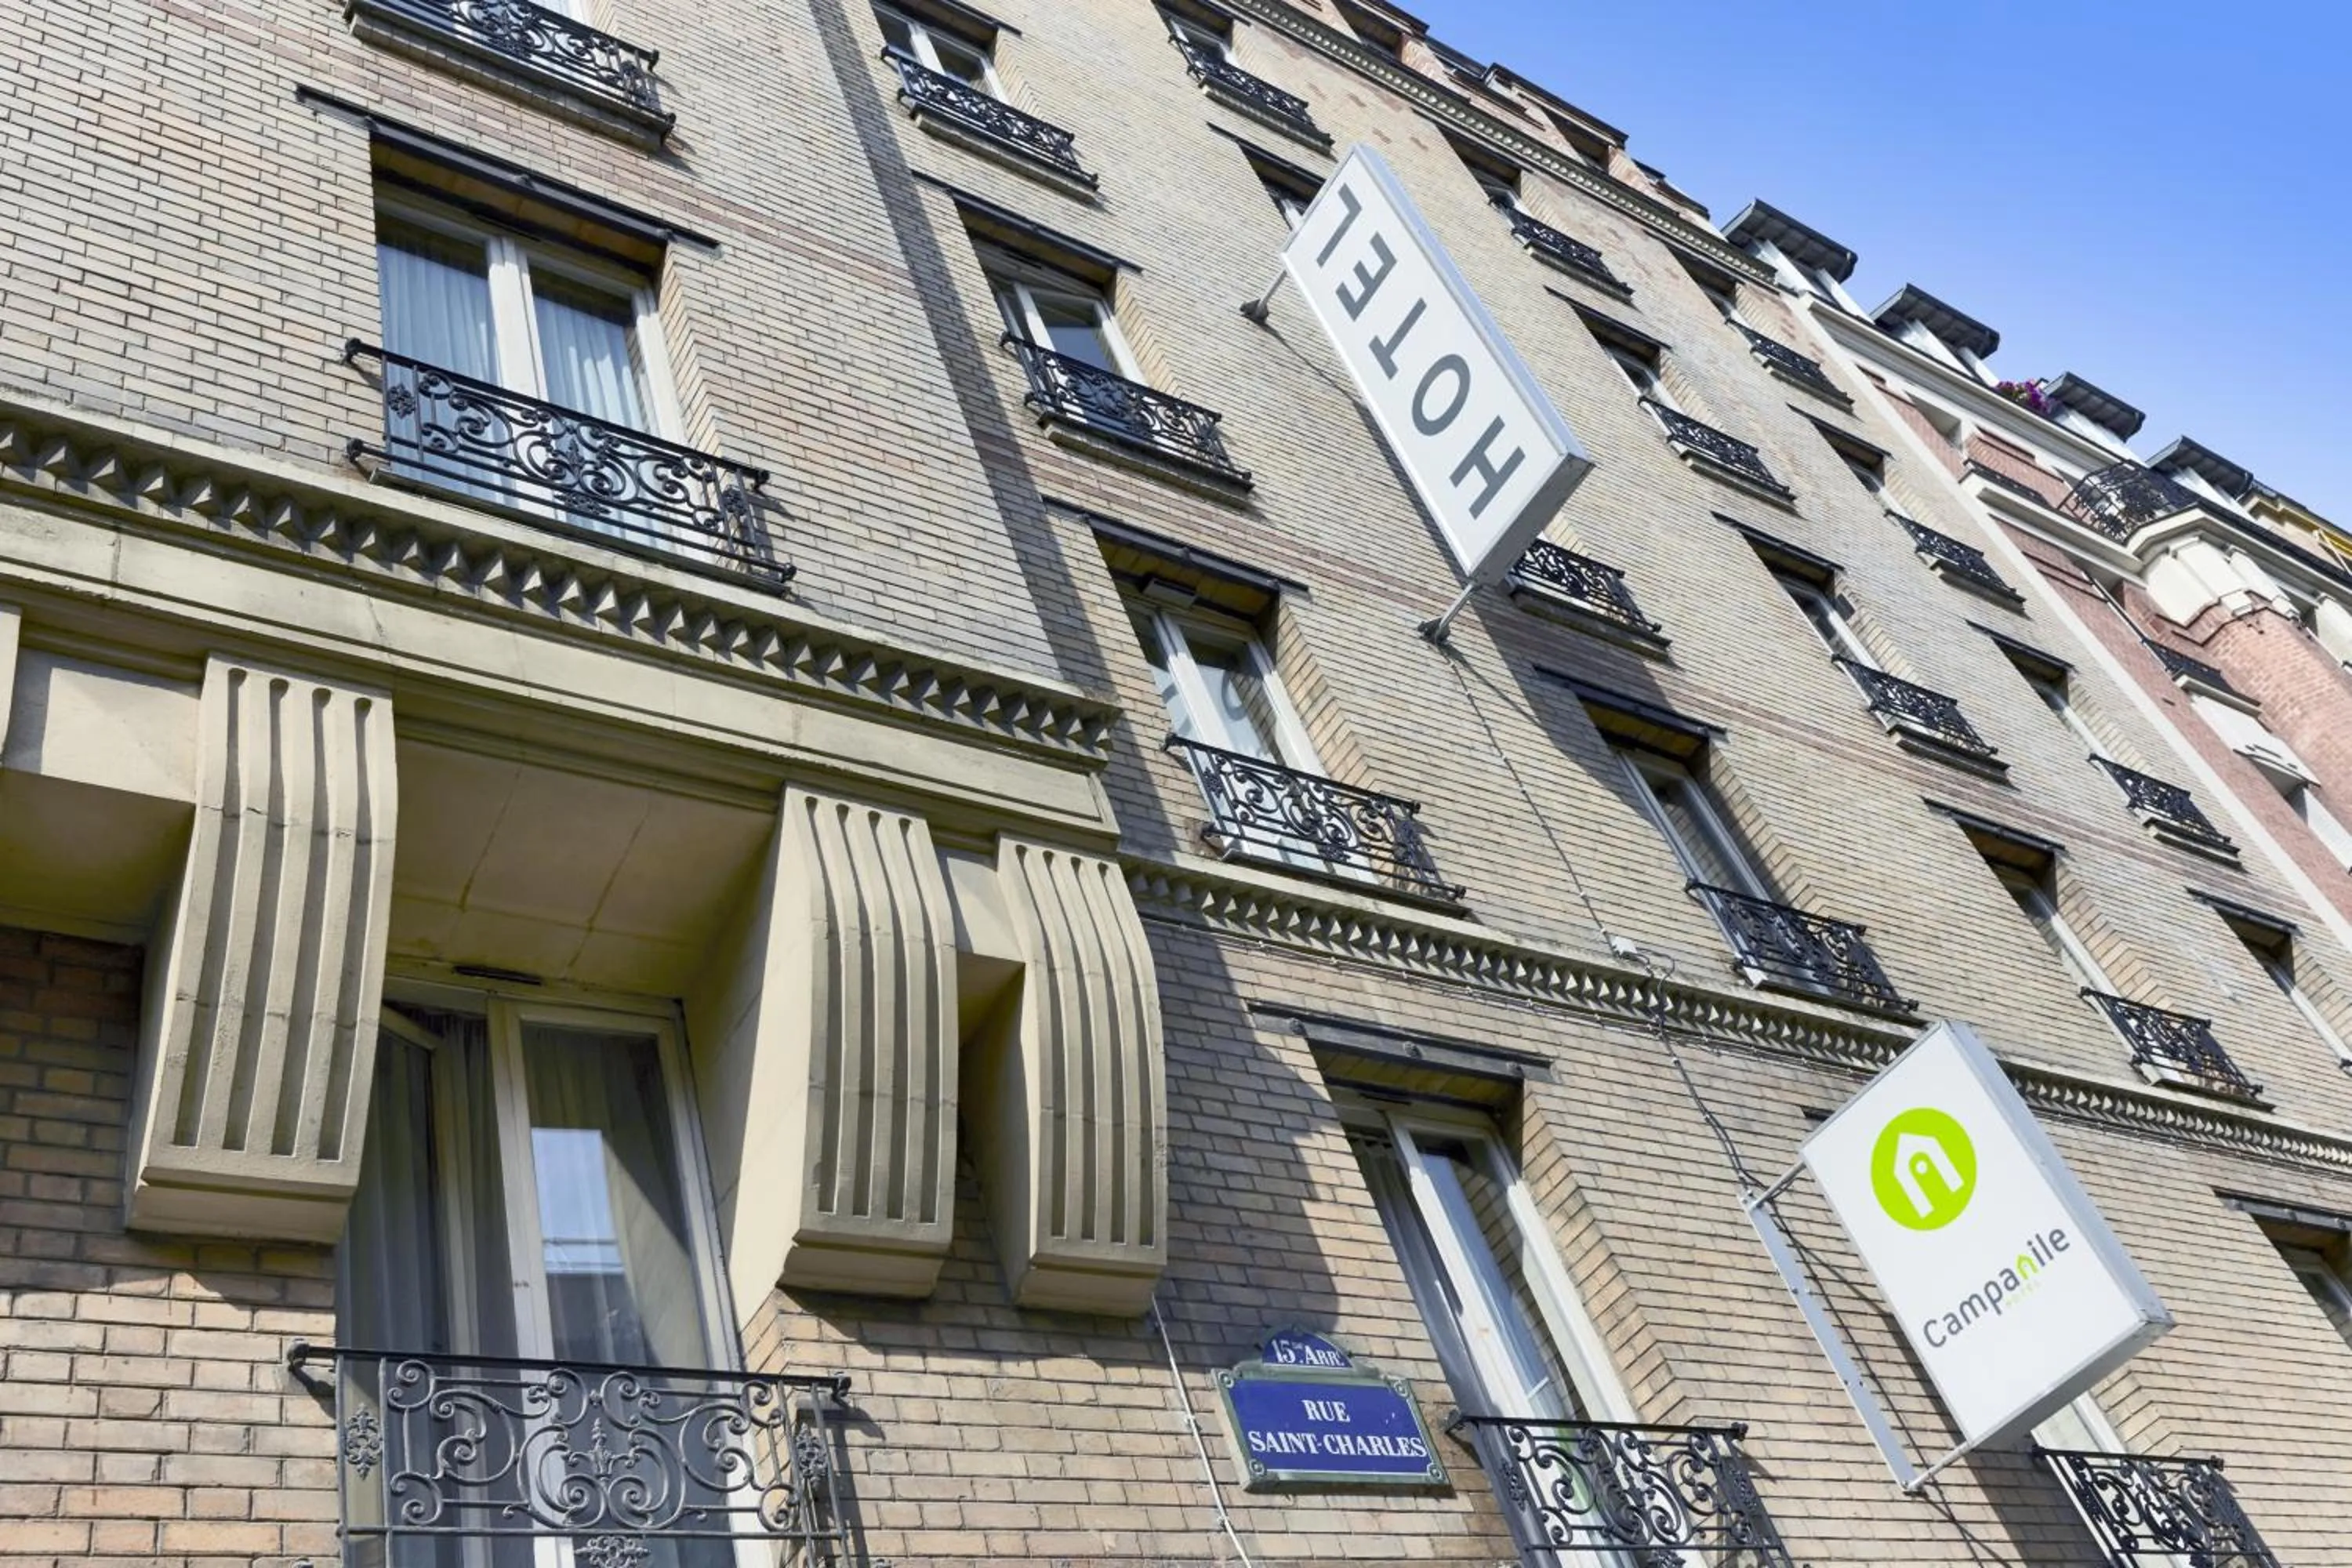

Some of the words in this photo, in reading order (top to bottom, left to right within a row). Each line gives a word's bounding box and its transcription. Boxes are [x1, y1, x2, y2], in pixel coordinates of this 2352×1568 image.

[1316, 183, 1526, 521] HOTEL
[1922, 1228, 2071, 1348] Campanile
[1248, 1431, 1428, 1457] SAINT-CHARLES
[1301, 1399, 1351, 1423] RUE
